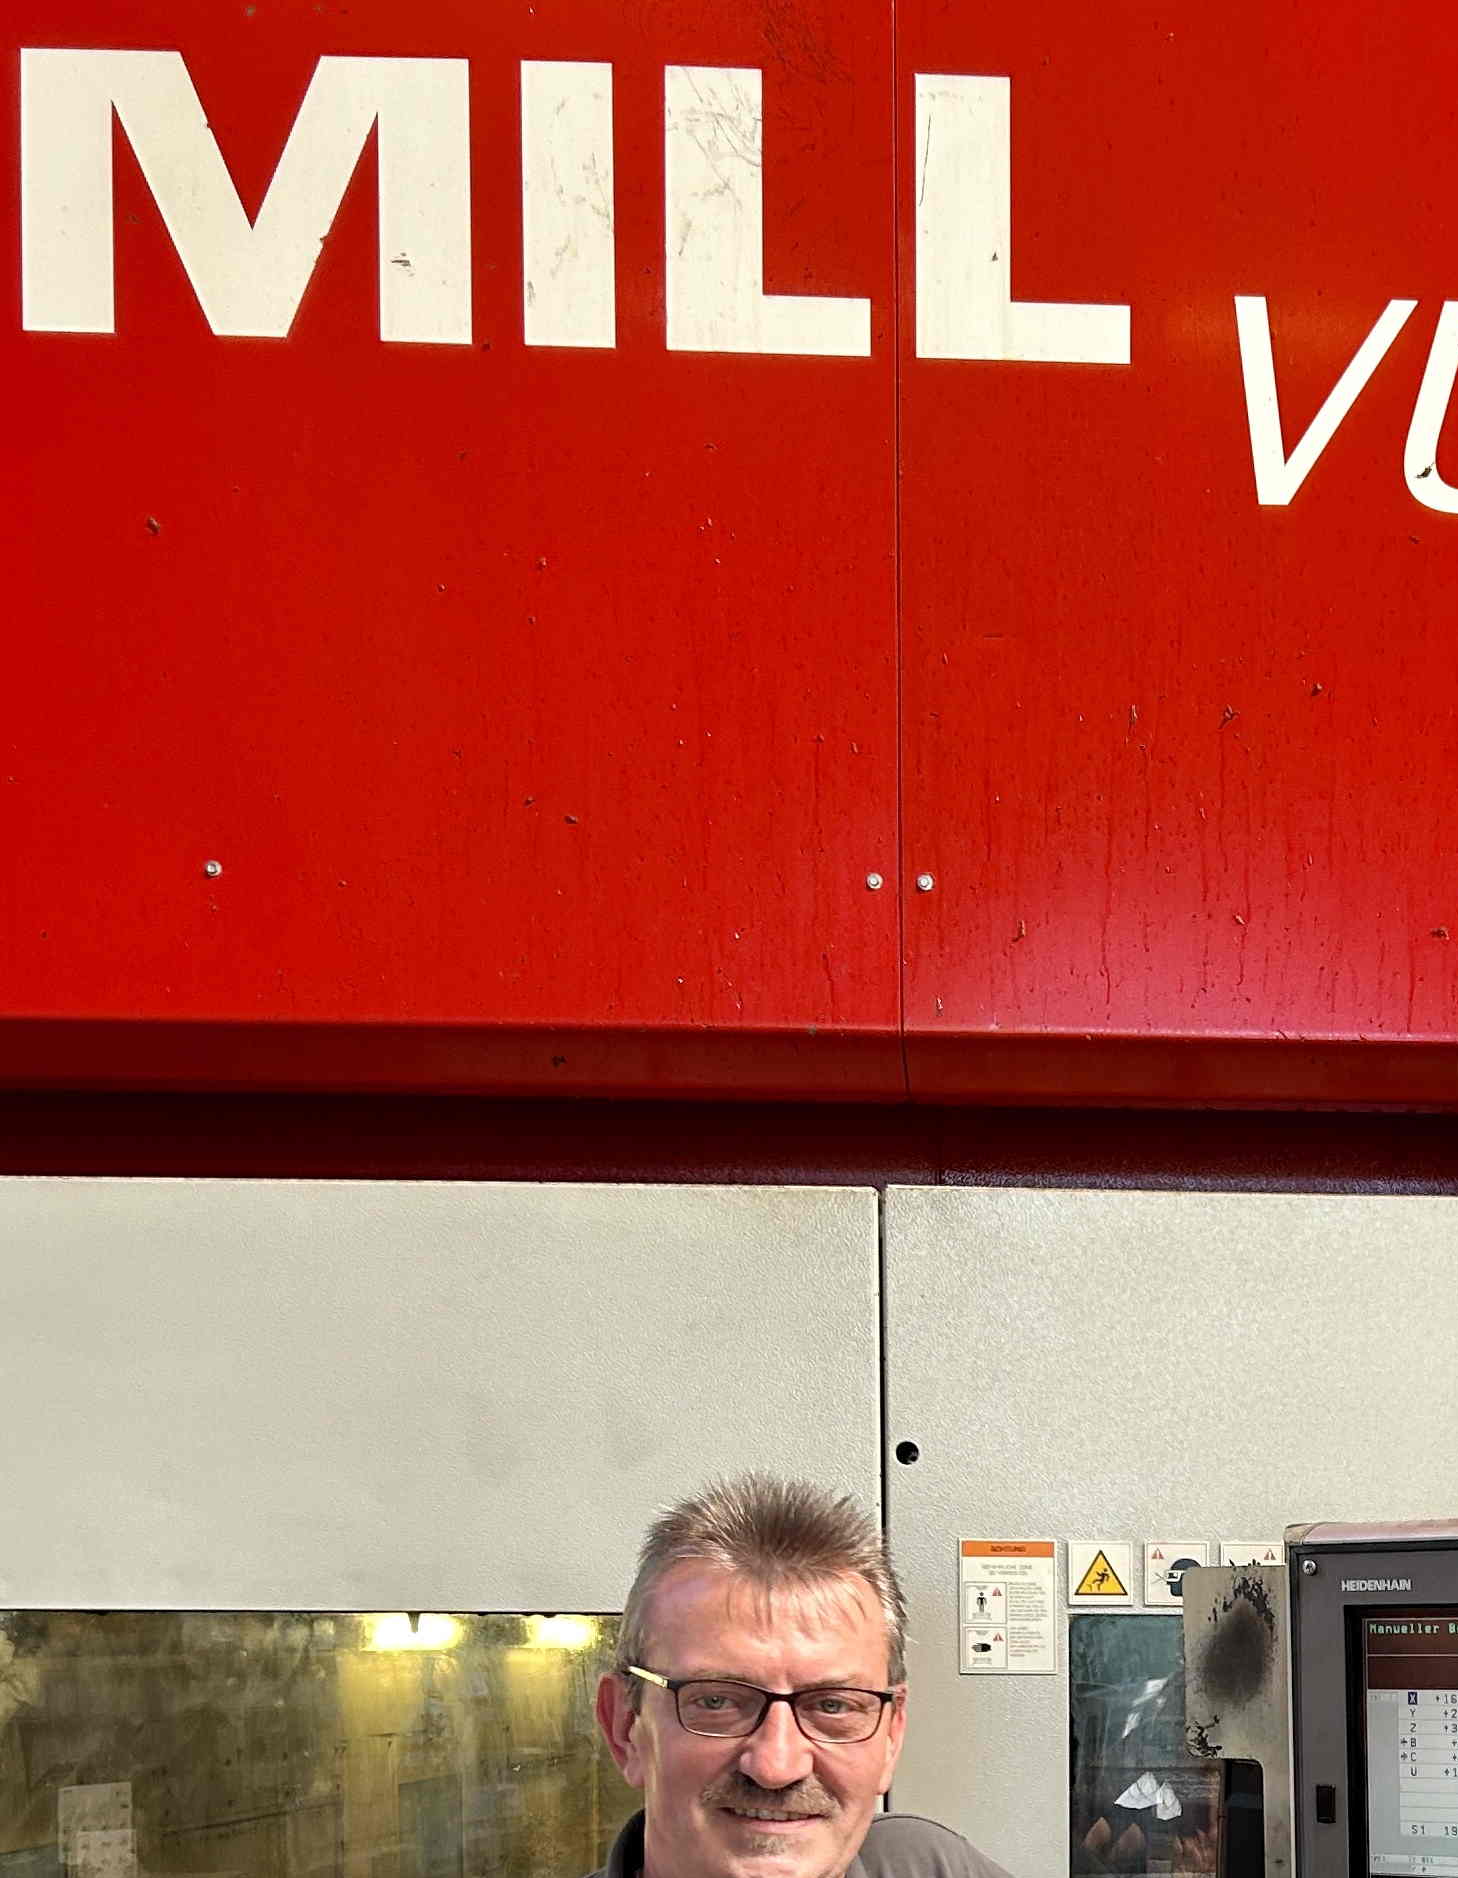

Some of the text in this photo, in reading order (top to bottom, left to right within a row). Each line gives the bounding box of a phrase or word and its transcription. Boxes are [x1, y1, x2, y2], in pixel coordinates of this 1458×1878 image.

[21, 47, 1130, 364] MILL
[1341, 1579, 1411, 1592] HEIDENHAIN
[1369, 1623, 1440, 1634] Manueller
[1410, 1708, 1416, 1718] Y
[1410, 1723, 1417, 1733] Z
[1410, 1767, 1417, 1776] U
